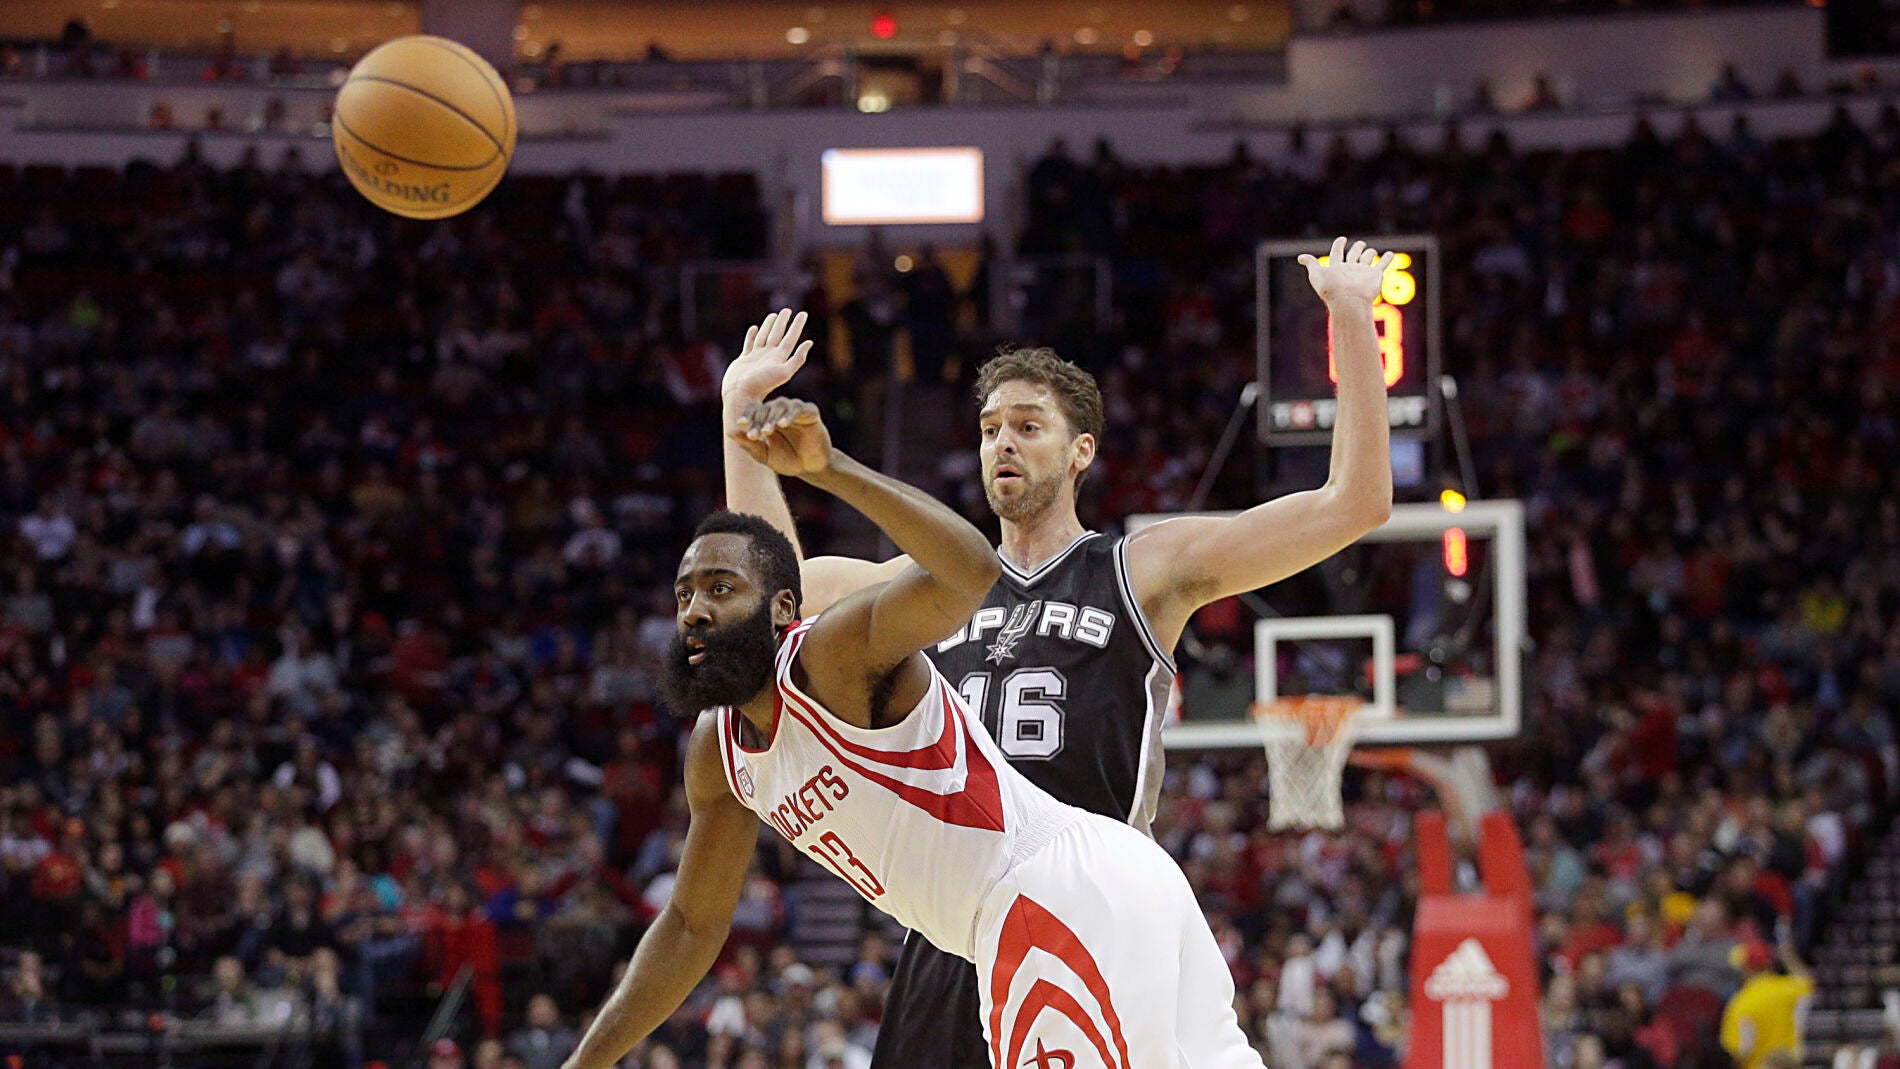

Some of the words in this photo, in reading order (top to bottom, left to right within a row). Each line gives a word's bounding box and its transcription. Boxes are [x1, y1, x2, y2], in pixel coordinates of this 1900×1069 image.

[340, 145, 450, 202] ALDING
[958, 666, 1067, 761] 16
[768, 765, 849, 841] OCKETS
[808, 831, 886, 900] 13
